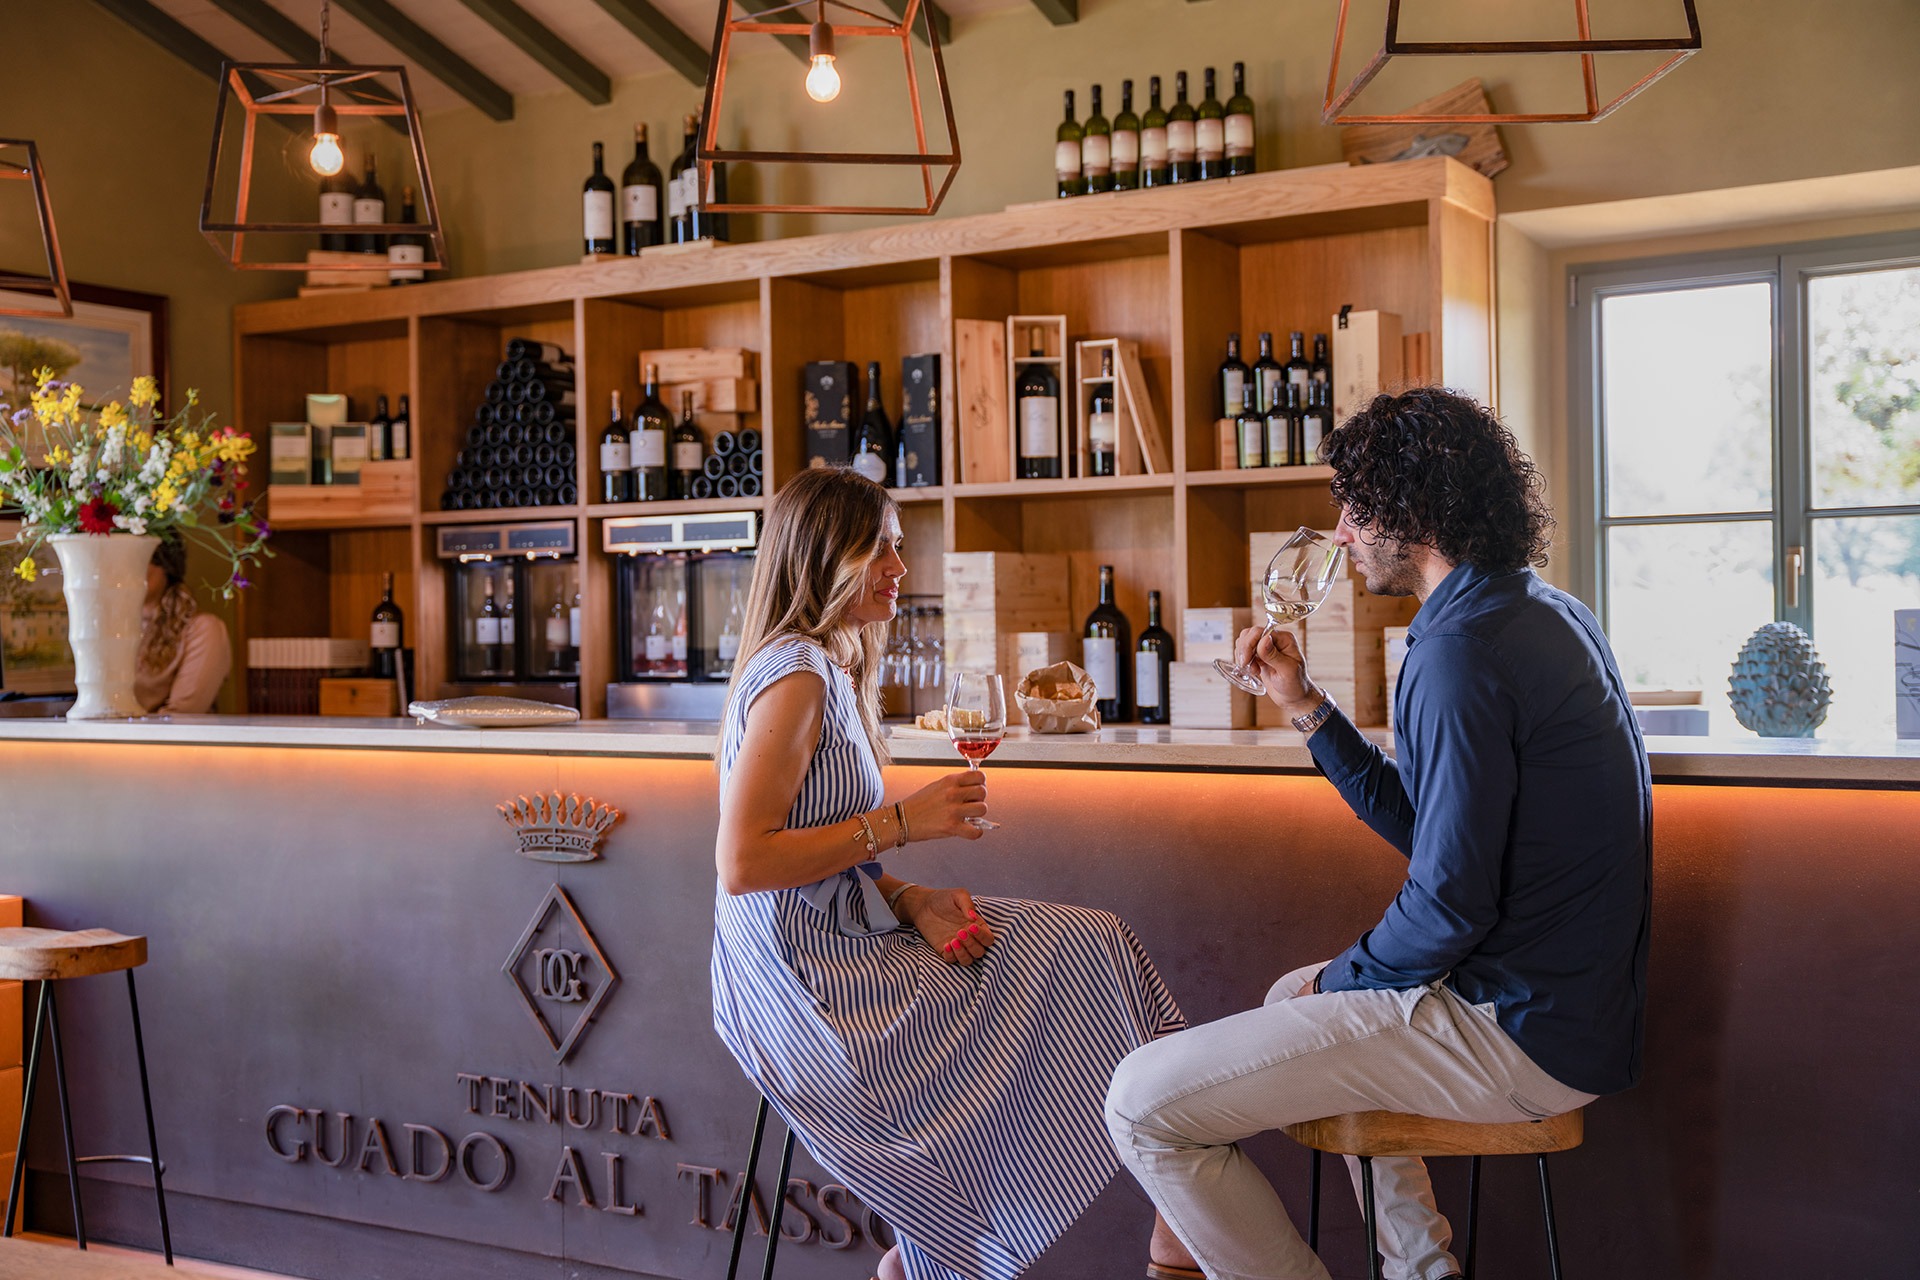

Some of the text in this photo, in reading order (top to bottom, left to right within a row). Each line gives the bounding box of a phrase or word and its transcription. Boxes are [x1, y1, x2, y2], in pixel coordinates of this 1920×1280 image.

[456, 1072, 671, 1140] TENUTA
[265, 1104, 513, 1192] GUADO
[543, 1146, 644, 1216] AL
